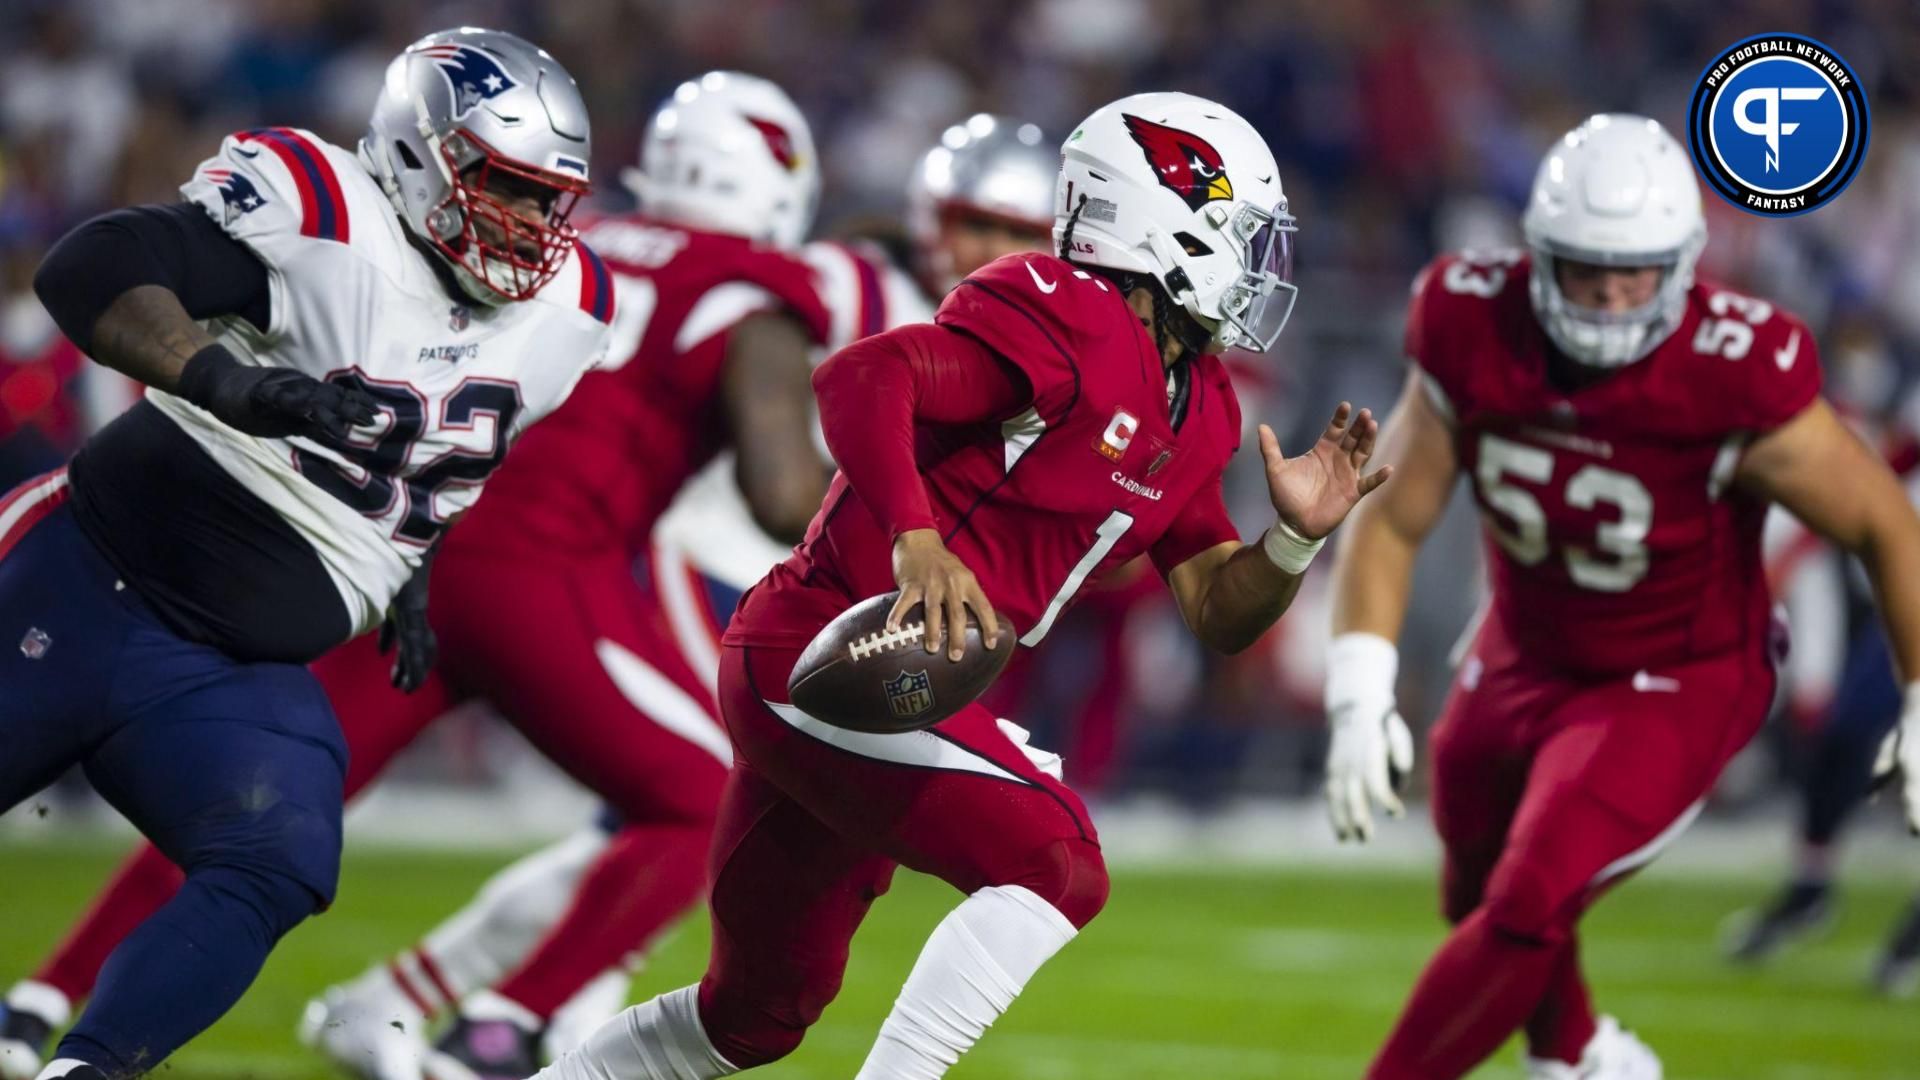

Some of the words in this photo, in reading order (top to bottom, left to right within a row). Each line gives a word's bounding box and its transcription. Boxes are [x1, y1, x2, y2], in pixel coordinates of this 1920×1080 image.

[1066, 181, 1074, 212] 1
[1103, 411, 1138, 451] C
[1111, 471, 1163, 500] CARDINALS
[1475, 432, 1655, 592] 53
[1018, 509, 1134, 648] 1
[891, 689, 931, 714] NFL
